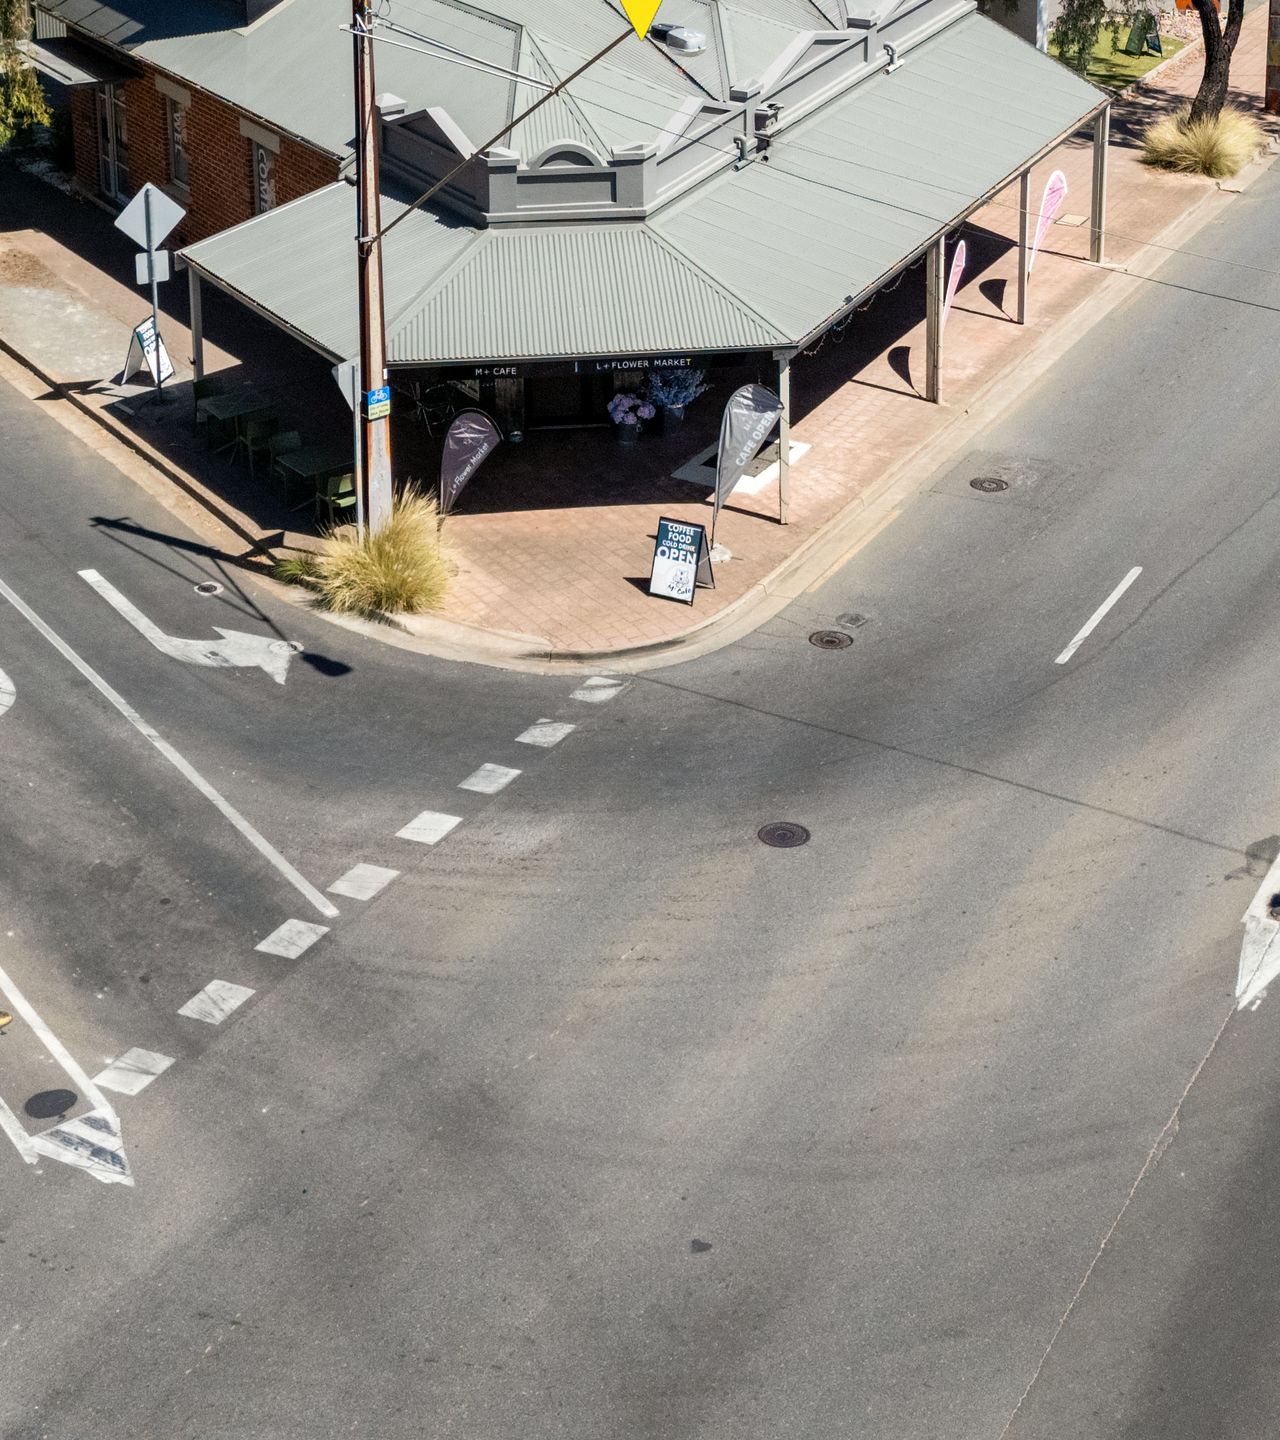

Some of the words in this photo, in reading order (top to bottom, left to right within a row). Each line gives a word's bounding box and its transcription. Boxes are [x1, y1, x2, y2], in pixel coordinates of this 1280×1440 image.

[612, 360, 649, 369] FLOWER
[654, 358, 692, 367] MARKET
[493, 367, 517, 375] CAFE
[736, 438, 757, 466] CAFE
[752, 411, 775, 440] OPEN
[454, 464, 472, 486] Flower
[470, 442, 489, 466] Market
[668, 524, 694, 536] COFFEE
[668, 532, 692, 543] FOOD
[662, 540, 678, 548] COLD
[678, 543, 696, 552] DRINK
[657, 546, 697, 566] OPEN
